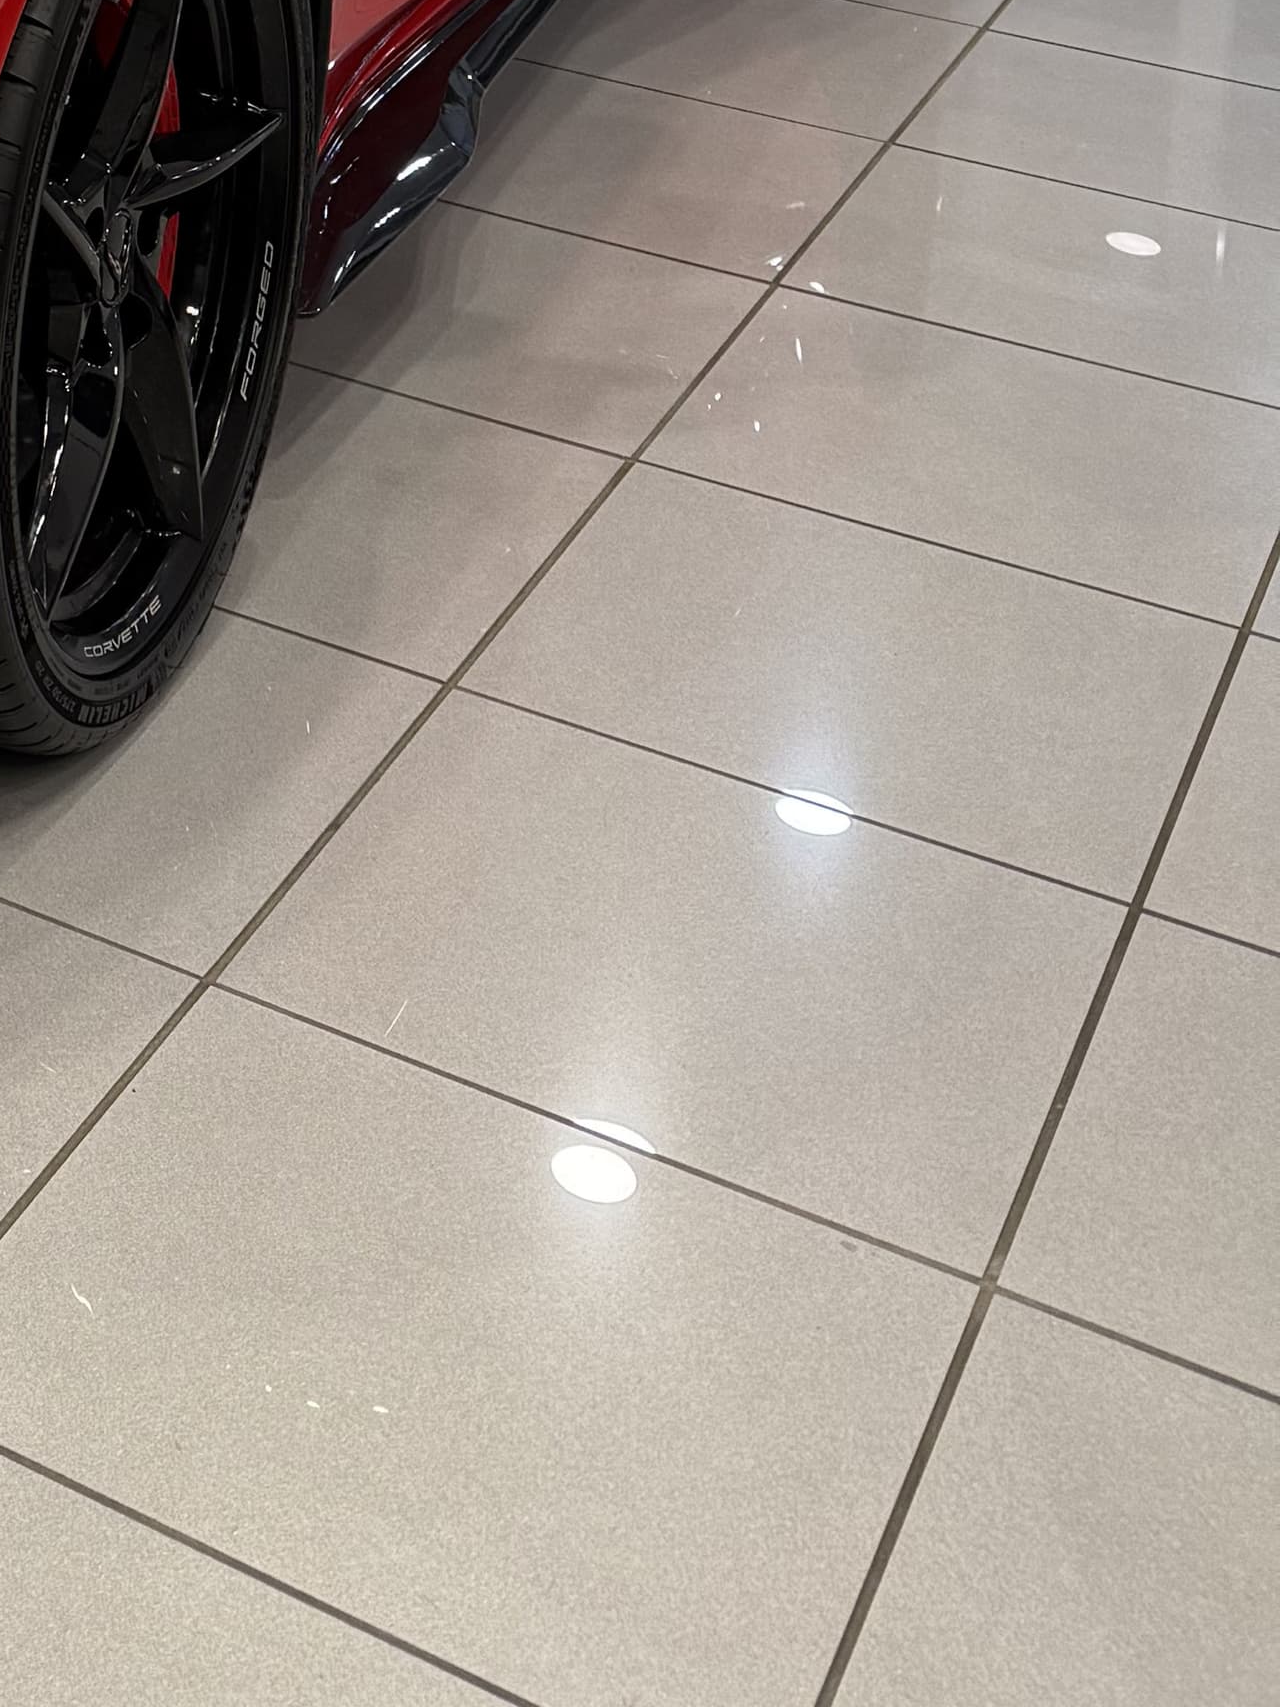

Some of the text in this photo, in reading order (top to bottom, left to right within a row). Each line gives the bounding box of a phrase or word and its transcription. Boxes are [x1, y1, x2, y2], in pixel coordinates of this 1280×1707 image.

[240, 240, 274, 402] FORGED
[83, 594, 162, 658] CORVETTE
[76, 681, 150, 725] MICHELIN
